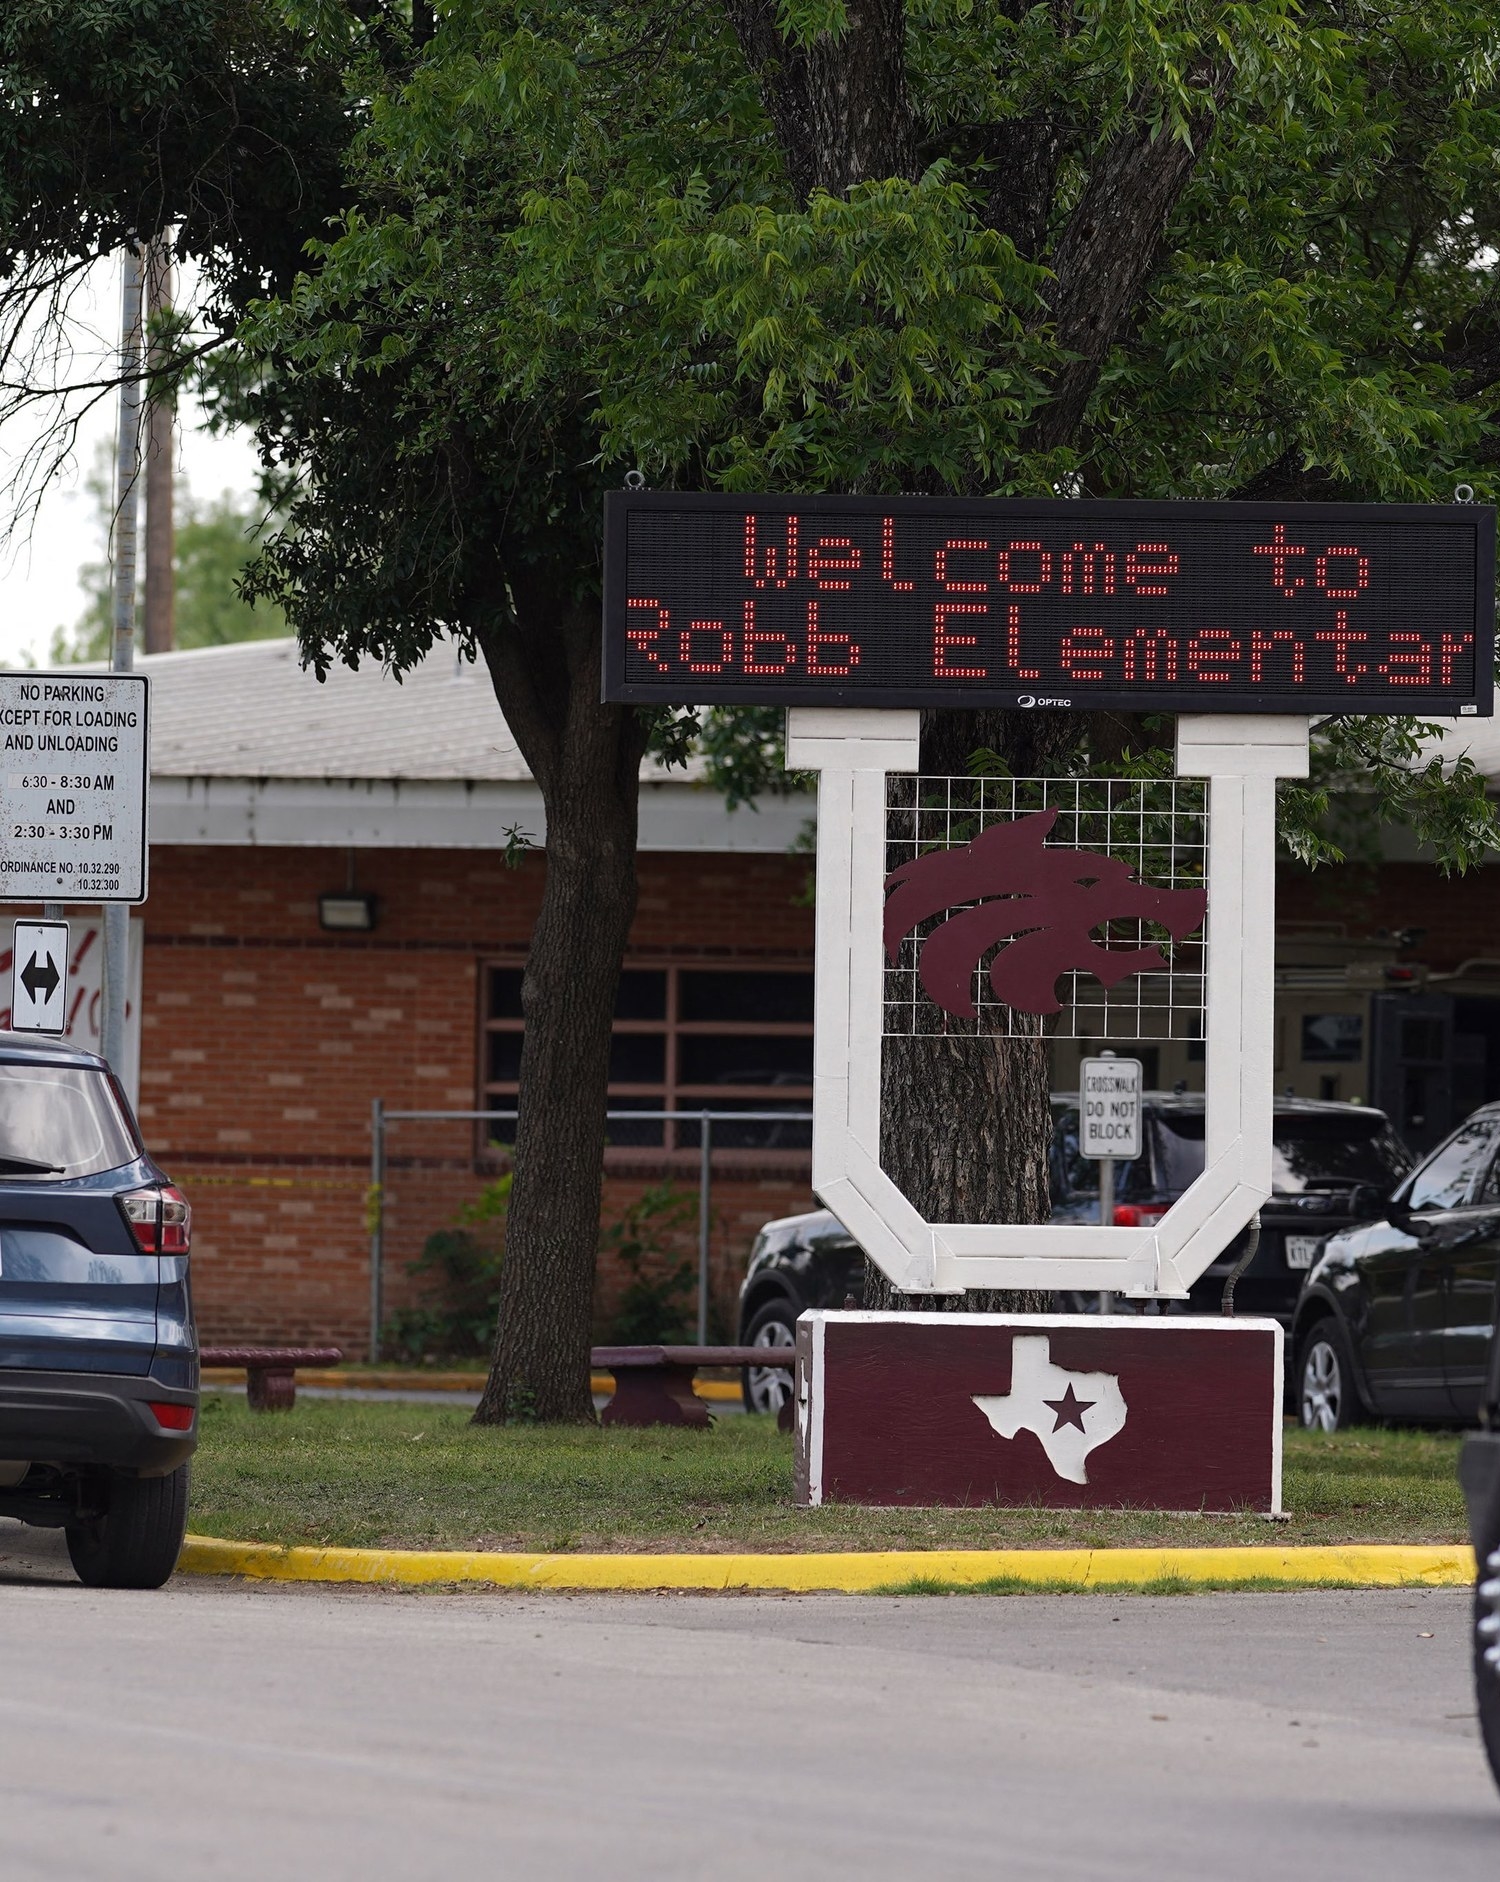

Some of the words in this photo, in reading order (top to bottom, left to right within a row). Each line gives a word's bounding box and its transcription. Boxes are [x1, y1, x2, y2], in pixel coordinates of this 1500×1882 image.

[744, 515, 1179, 596] Welcome
[1252, 524, 1370, 598] to
[934, 603, 1475, 686] Elementar
[20, 685, 40, 700] NO
[44, 686, 105, 702] PARKING
[1037, 697, 1072, 707] OPTEC
[44, 711, 72, 726] FOR
[76, 711, 137, 728] LOADING
[5, 735, 34, 750] AND
[38, 735, 118, 752] UNLOADING
[22, 775, 48, 789] 6:30
[61, 776, 91, 790] 8:30
[94, 775, 115, 790] AM
[46, 799, 75, 815] AND
[14, 825, 45, 839] 2:30
[59, 826, 90, 840] 3:30
[93, 825, 113, 841] PM
[0, 861, 56, 874] ORDINANCE
[59, 862, 76, 874] NO.
[78, 862, 120, 875] 10.32.290
[78, 878, 119, 891] 10.32.300
[1087, 1076, 1136, 1094] CROSSWALK
[1087, 1101, 1105, 1117] DO
[1110, 1101, 1135, 1118] NOT
[1089, 1122, 1132, 1140] BLOCK
